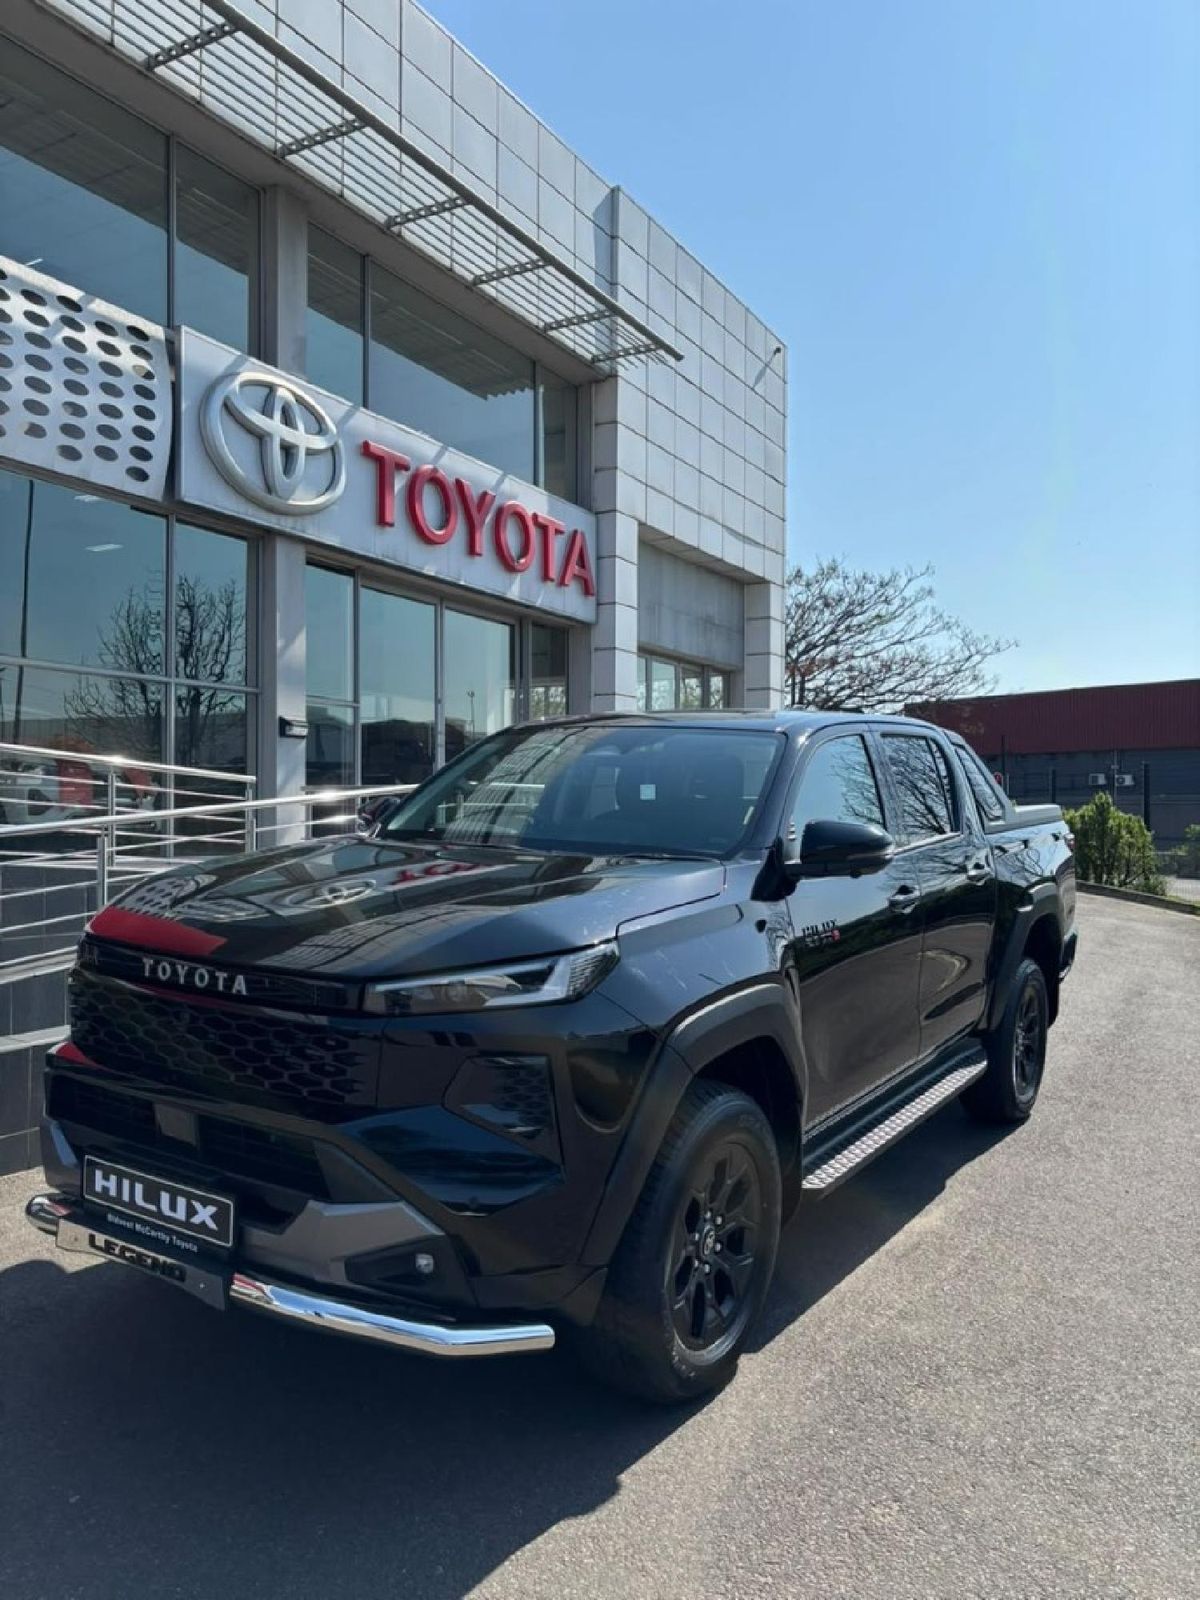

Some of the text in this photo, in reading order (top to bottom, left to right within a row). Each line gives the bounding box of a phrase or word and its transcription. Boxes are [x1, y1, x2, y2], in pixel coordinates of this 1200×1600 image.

[360, 439, 595, 597] TOYOTA
[142, 957, 248, 996] TOYOTA
[94, 1169, 219, 1231] HILUX
[88, 1233, 187, 1283] LEGEND
[172, 1235, 198, 1253] Toyota
